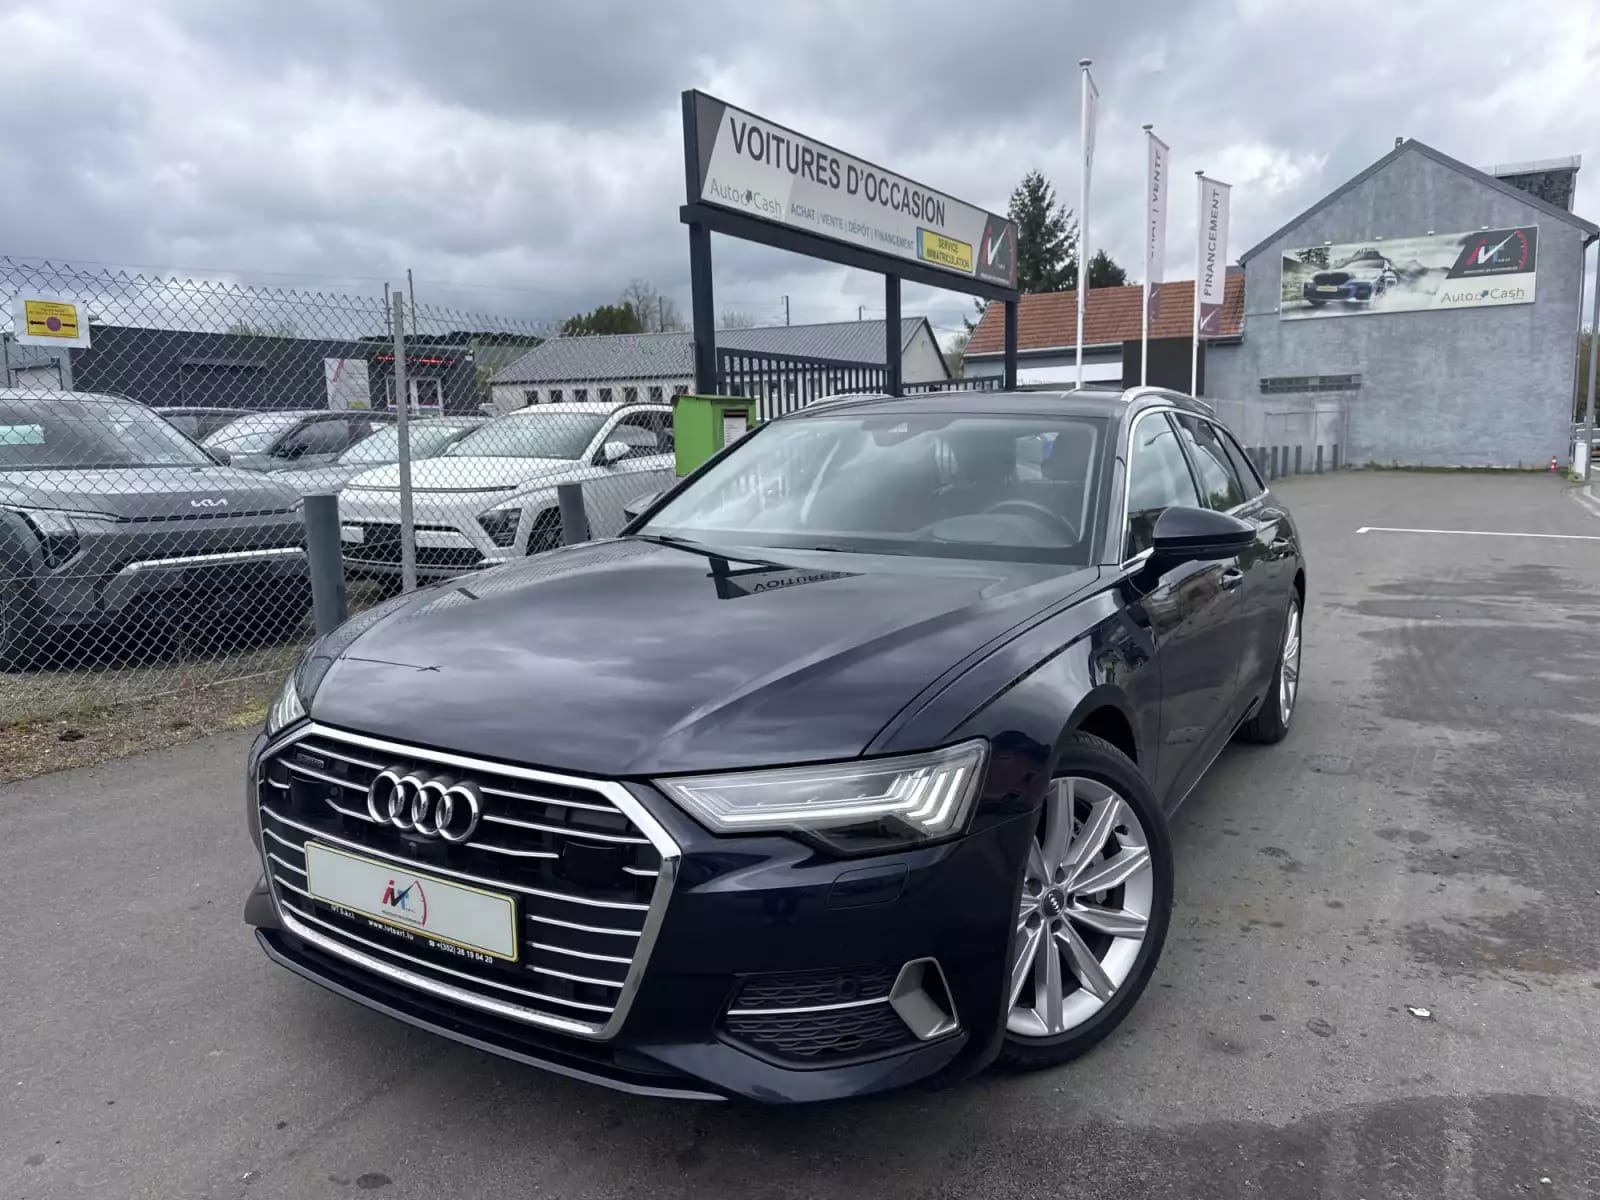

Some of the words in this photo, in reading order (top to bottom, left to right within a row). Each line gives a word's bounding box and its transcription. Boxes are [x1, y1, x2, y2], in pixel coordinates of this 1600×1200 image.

[730, 117, 840, 189] VOITURES
[847, 164, 945, 228] D'OCCASION
[753, 192, 782, 215] Cash
[791, 203, 815, 220] ACHAT
[821, 212, 844, 231] VENTE
[938, 238, 959, 254] SERVICE
[1204, 189, 1220, 296] FINANCEMENT
[1491, 288, 1525, 300] Cash
